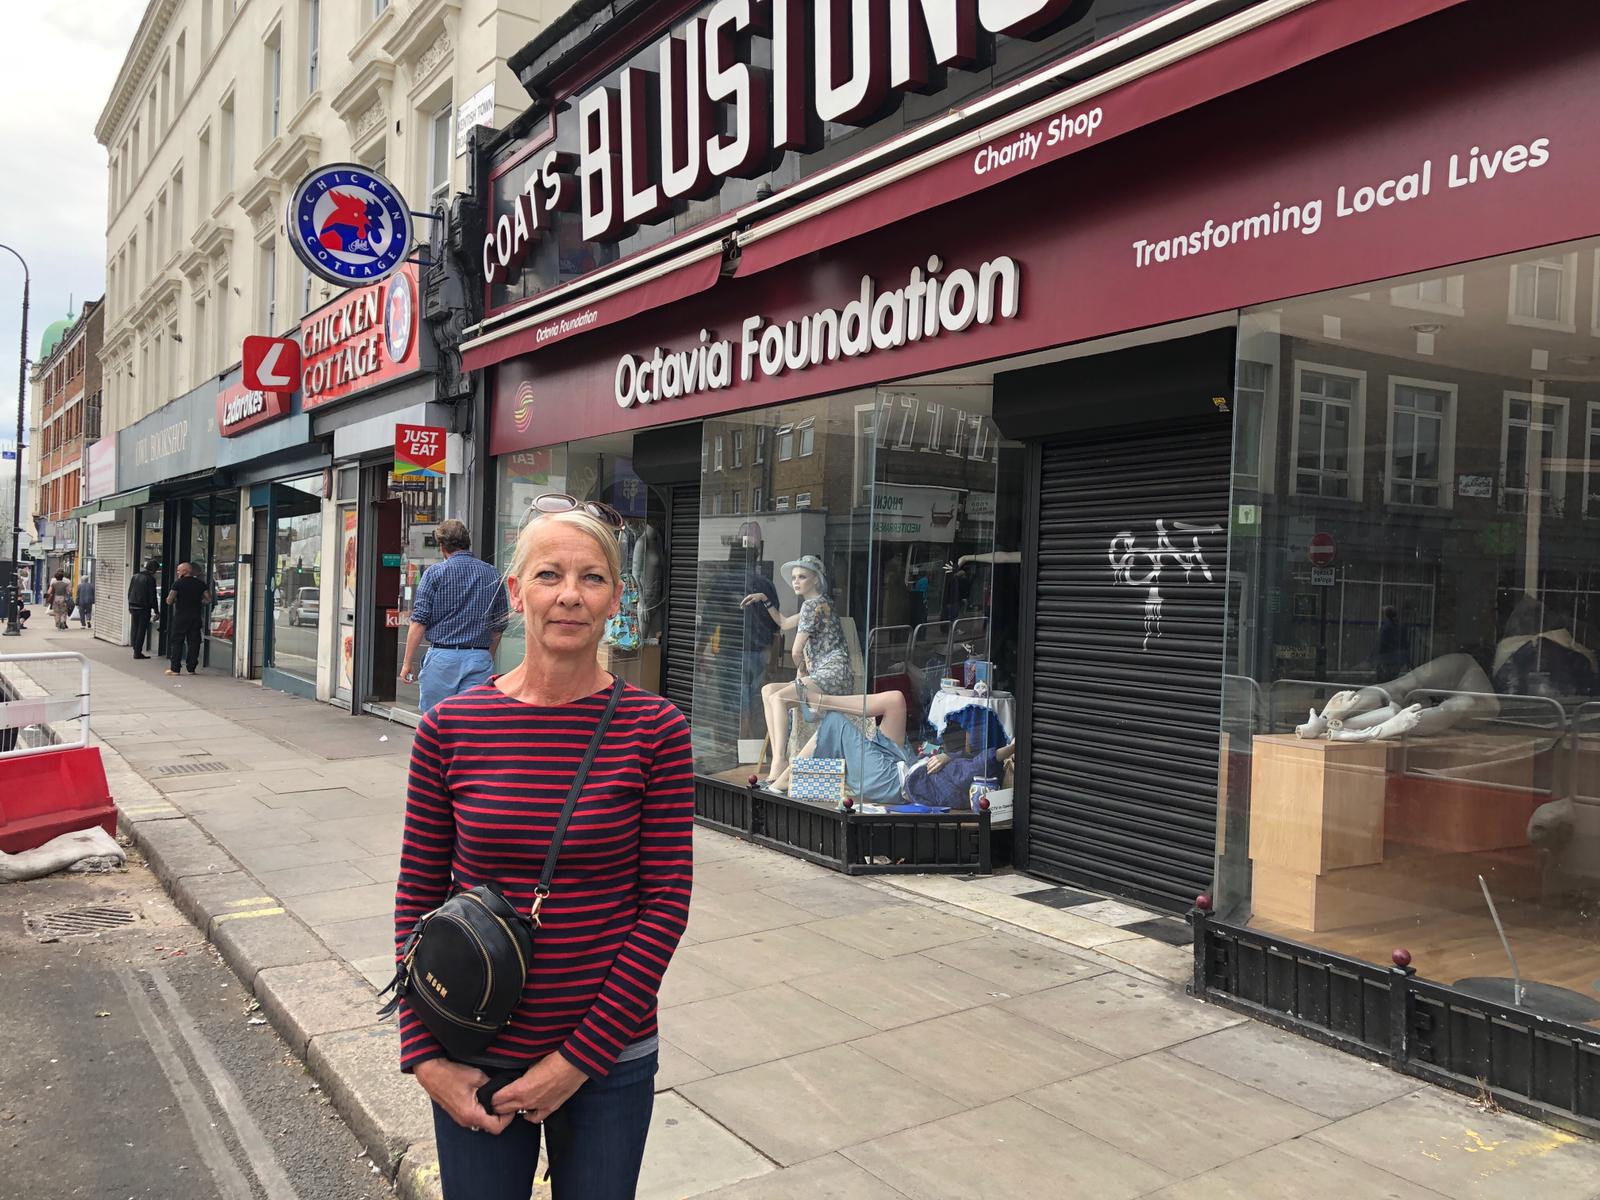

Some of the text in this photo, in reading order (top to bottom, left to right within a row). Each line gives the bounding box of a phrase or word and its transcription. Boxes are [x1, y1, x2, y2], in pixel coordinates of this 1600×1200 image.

[579, 0, 1052, 242] BLUSTO
[973, 106, 1103, 175] Charity Shop
[305, 173, 401, 221] CHICKEN
[483, 150, 562, 284] COATS
[1132, 137, 1550, 268] Transforming Local Lives
[306, 235, 397, 276] COTTAGE
[302, 287, 381, 358] CHICKEN
[536, 309, 598, 343] Octavia Foundation
[614, 254, 1020, 408] Octavia Foundation
[302, 335, 380, 397] COTTAGE
[223, 390, 264, 426] Ladbrokes
[403, 429, 439, 444] JUST
[410, 443, 438, 456] EAT
[386, 613, 411, 627] kuk
